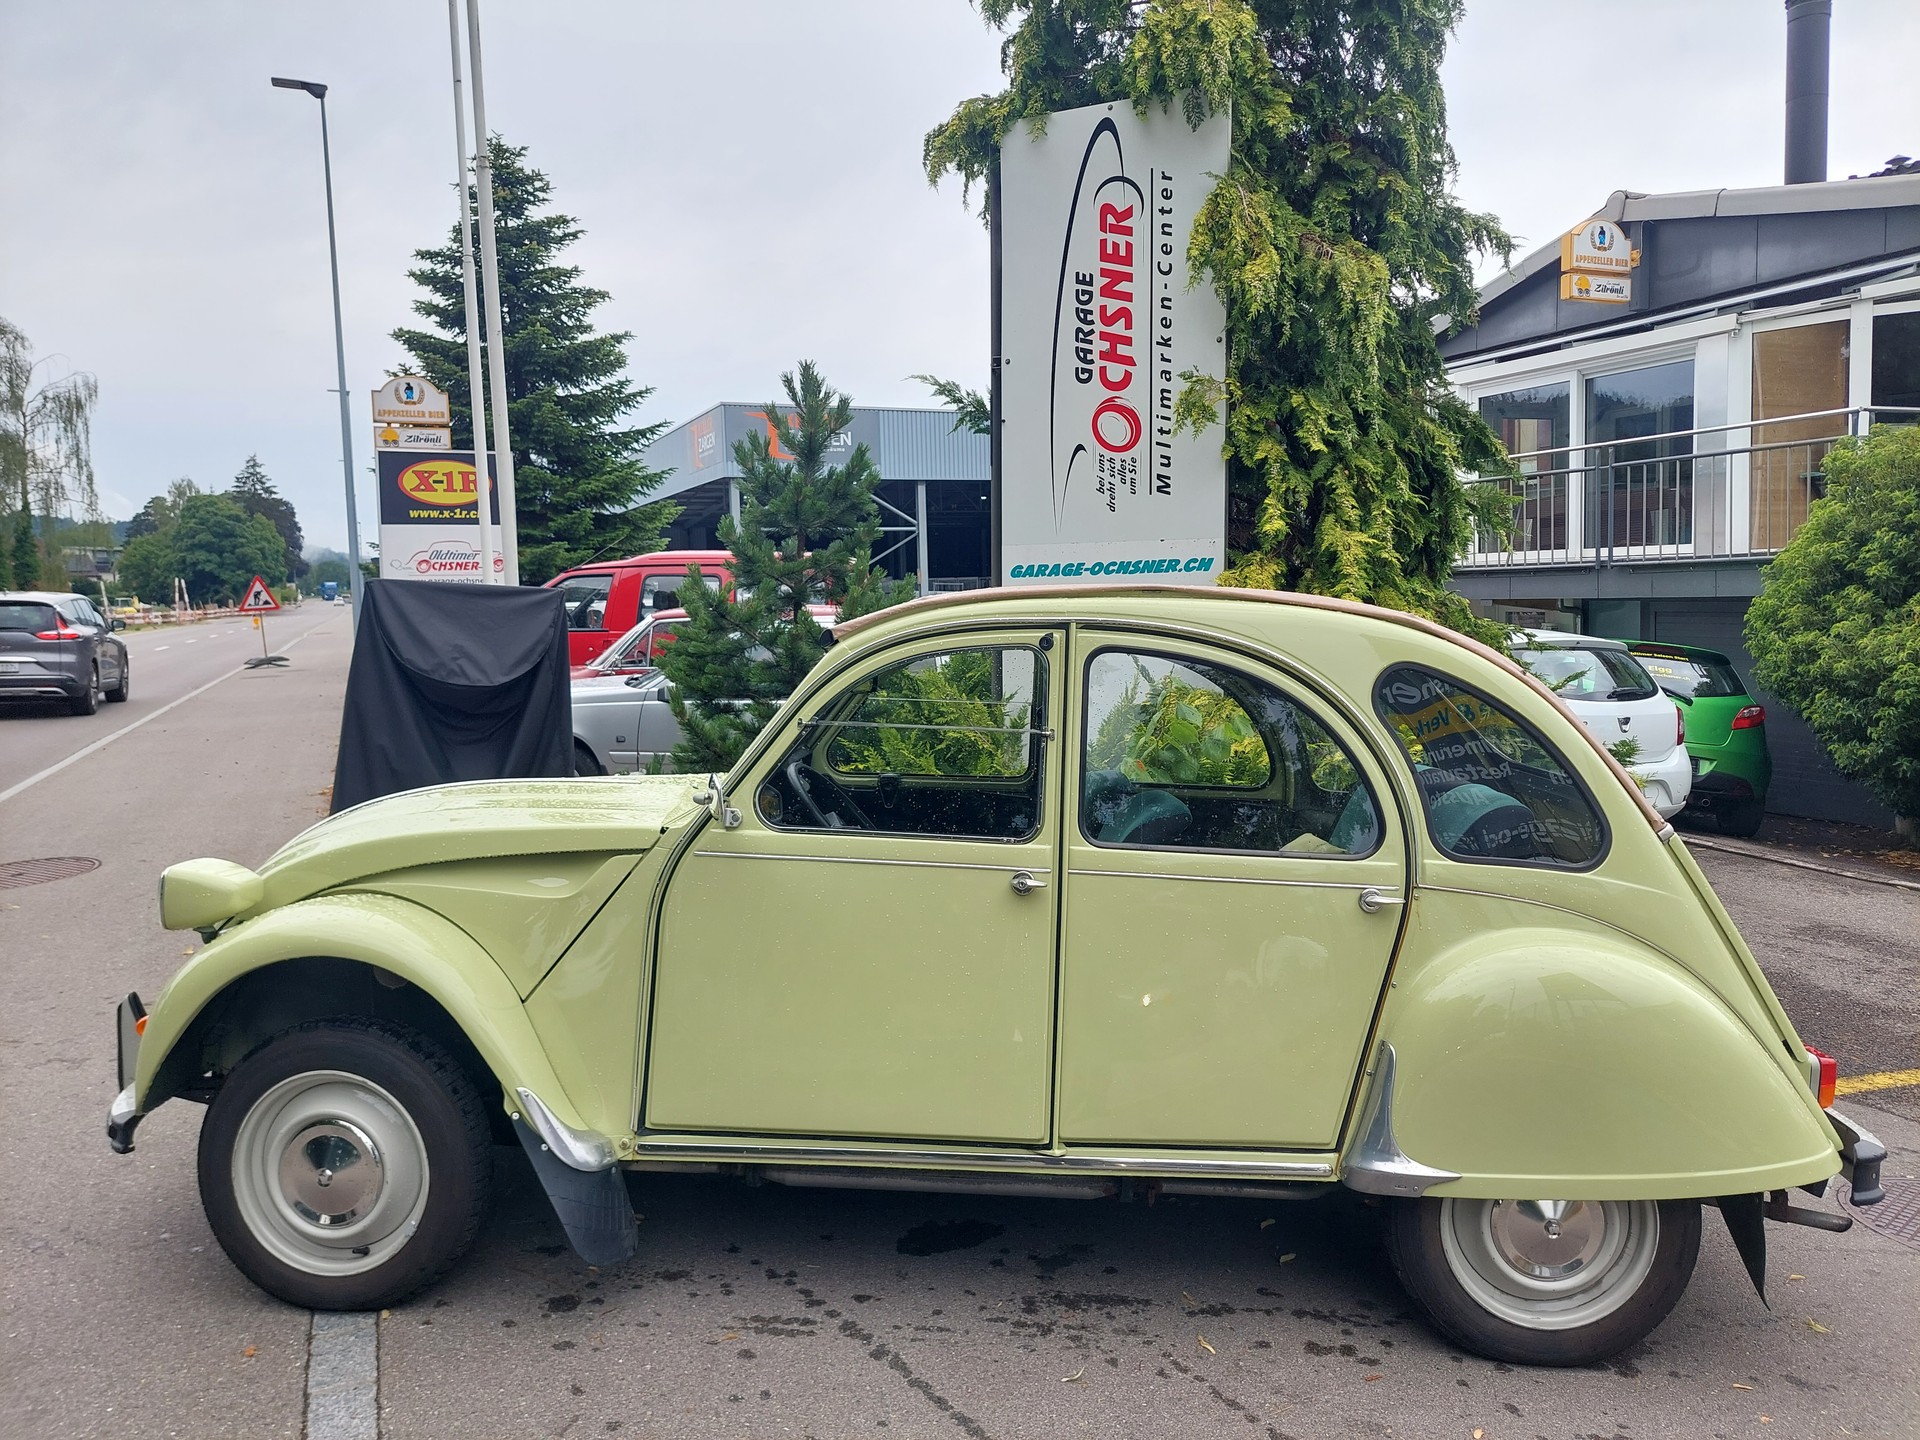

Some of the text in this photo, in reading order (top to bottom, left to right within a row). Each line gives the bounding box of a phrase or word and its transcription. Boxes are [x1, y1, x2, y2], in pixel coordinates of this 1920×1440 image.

[1575, 255, 1628, 267] APPENZELLER BIER
[1594, 284, 1624, 294] Zitrönli
[1074, 271, 1095, 384] GARAGE
[1154, 170, 1174, 496] Multimarken-Center
[377, 409, 426, 418] APPENZELLER
[404, 435, 442, 444] Zitrönli
[1117, 458, 1127, 485] alles
[1128, 456, 1137, 495] um Sie
[1095, 475, 1105, 495] bei
[1106, 457, 1116, 513] dreht sich
[429, 549, 480, 561] Oldtimer
[1010, 557, 1215, 578] GARAGE-OCHSNER.CH
[1648, 665, 1673, 674] Elgg
